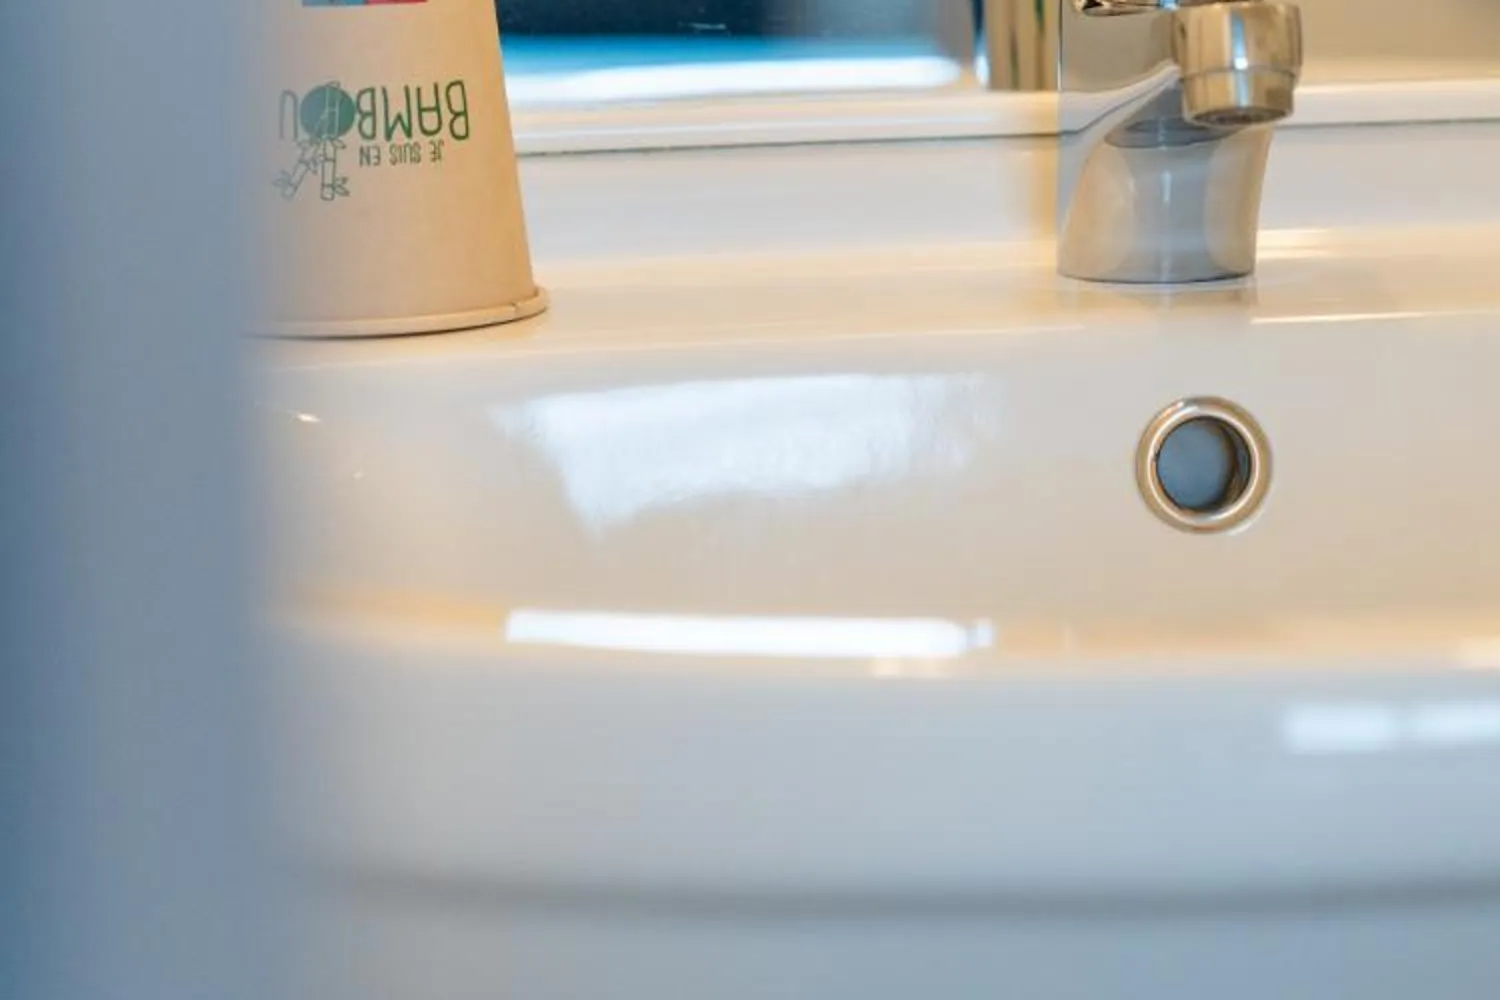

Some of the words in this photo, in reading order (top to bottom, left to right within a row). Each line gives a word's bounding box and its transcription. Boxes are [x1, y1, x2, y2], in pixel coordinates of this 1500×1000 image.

[359, 146, 381, 167] EN
[389, 141, 421, 165] SUIS
[429, 139, 444, 163] JE
